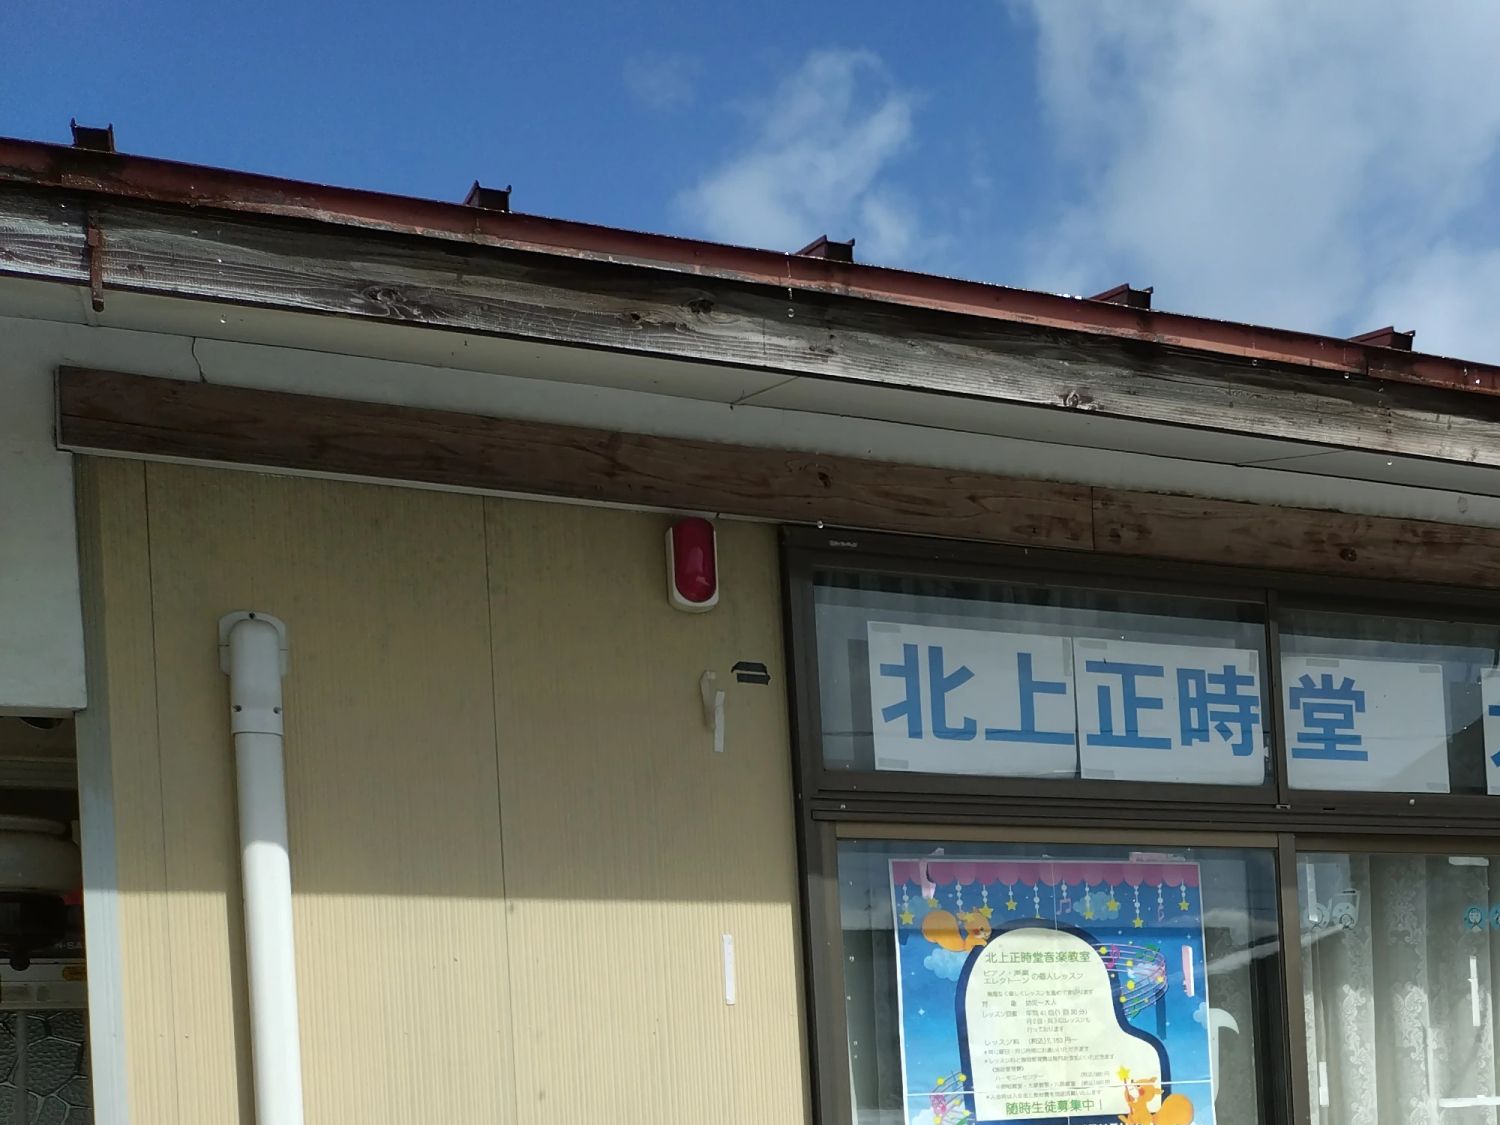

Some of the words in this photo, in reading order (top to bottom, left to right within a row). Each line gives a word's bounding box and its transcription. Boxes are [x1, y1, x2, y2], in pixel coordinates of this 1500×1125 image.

[879, 643, 1369, 762] 北上正時堂
[985, 951, 1091, 964] 北上正時堂音楽教室
